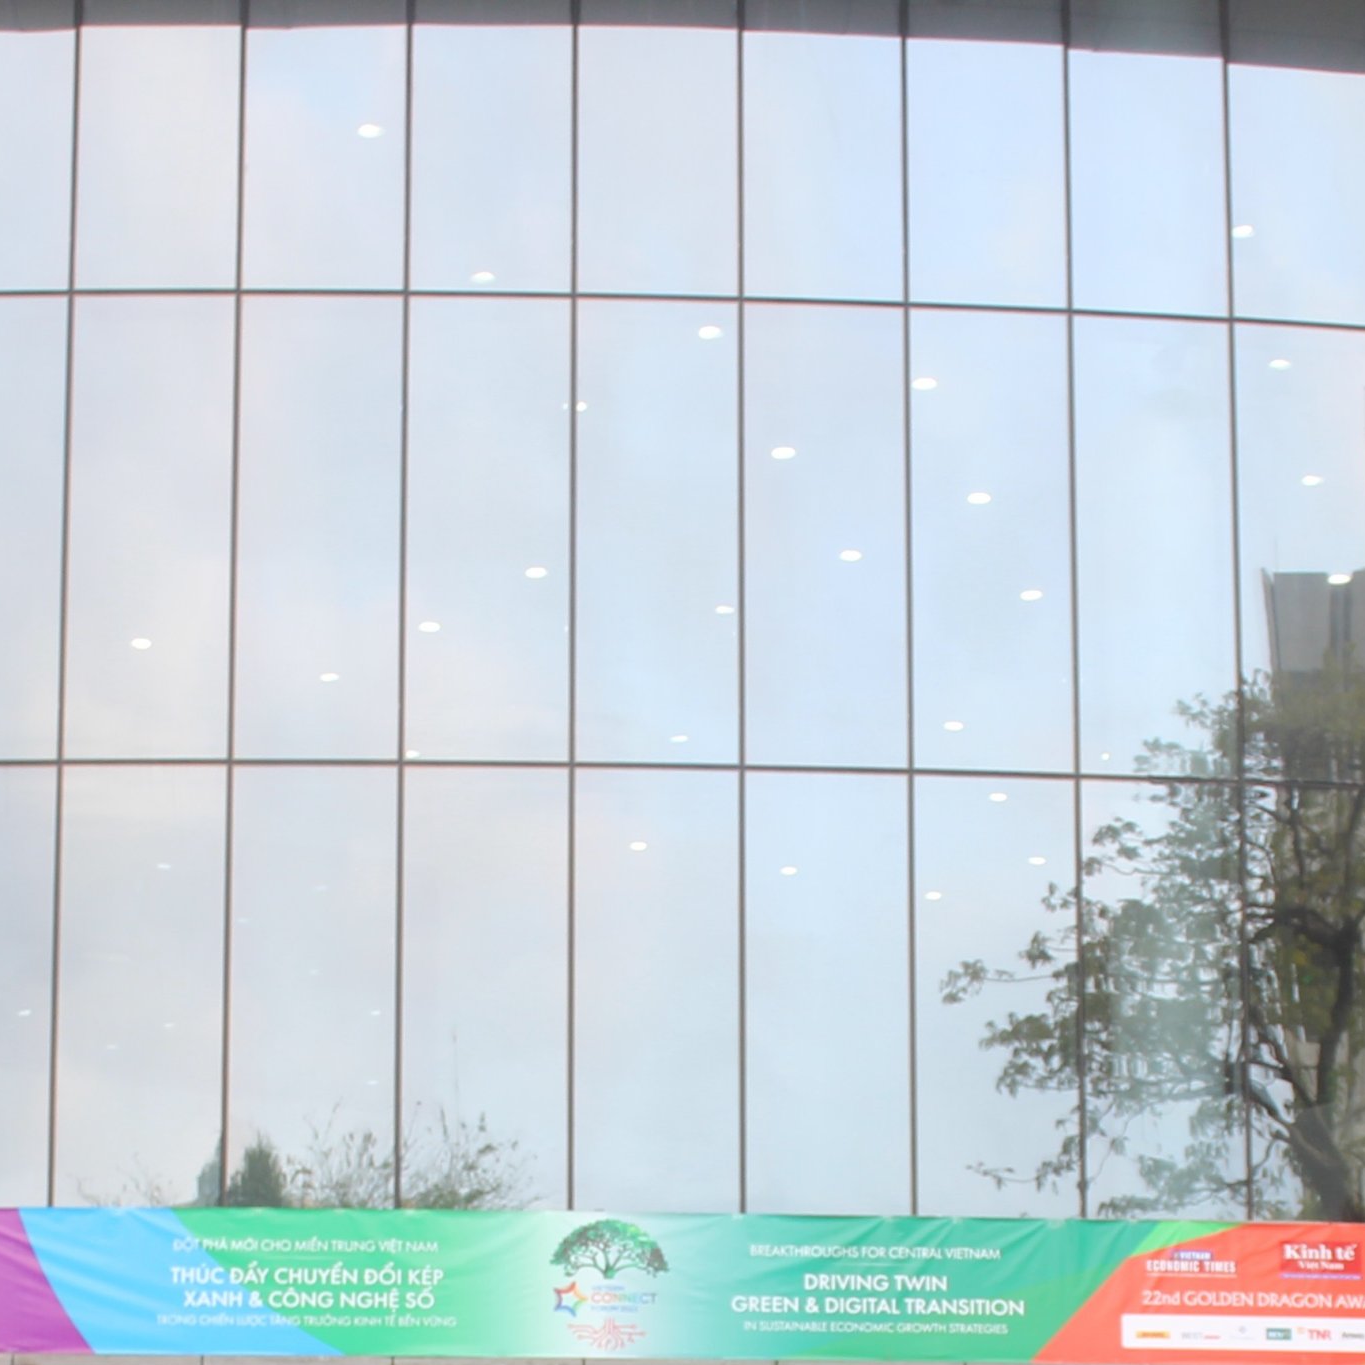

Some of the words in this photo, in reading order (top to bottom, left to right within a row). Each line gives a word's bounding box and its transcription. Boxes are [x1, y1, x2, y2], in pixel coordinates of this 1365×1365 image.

[261, 1239, 292, 1252] CHO
[330, 1240, 376, 1252] TRUNG
[378, 1238, 403, 1254] VIỆT
[405, 1240, 439, 1253] NAM
[749, 1244, 859, 1259] BREAKTHROUGHS
[861, 1246, 886, 1259] FOR
[888, 1246, 943, 1260] CENTRAL
[944, 1247, 1001, 1260] VIETNAM
[1283, 1243, 1332, 1261] Kinh
[1335, 1243, 1358, 1261] tế
[1146, 1259, 1201, 1273] ECONOMIC
[1204, 1260, 1237, 1273] TIMES
[1321, 1261, 1345, 1271] Nam
[171, 1264, 225, 1285] THÚC
[408, 1264, 444, 1286] KÉP
[804, 1273, 890, 1292] DRIVING
[893, 1275, 948, 1292] TWIN
[184, 1289, 242, 1308] XANH
[248, 1291, 263, 1308] &
[268, 1286, 334, 1309] CÔNG
[339, 1287, 399, 1313] NGHỆ
[405, 1286, 436, 1310] SỐ
[591, 1291, 657, 1305] CONNECT
[731, 1295, 799, 1313] GREEN
[804, 1296, 819, 1314] &
[825, 1297, 901, 1315] DIGITAL
[903, 1299, 1025, 1317] TRANSITION
[1141, 1290, 1181, 1306] 22nd
[1183, 1290, 1253, 1307] GOLDEN
[1257, 1291, 1332, 1308] DRAGON
[353, 1316, 382, 1327] KINH
[744, 1321, 756, 1332] IN
[758, 1321, 828, 1333] SUSTAINABLE
[830, 1322, 895, 1333] ECONOMIC
[896, 1322, 947, 1334] GROWTH
[949, 1323, 1009, 1335] STRATEGIES
